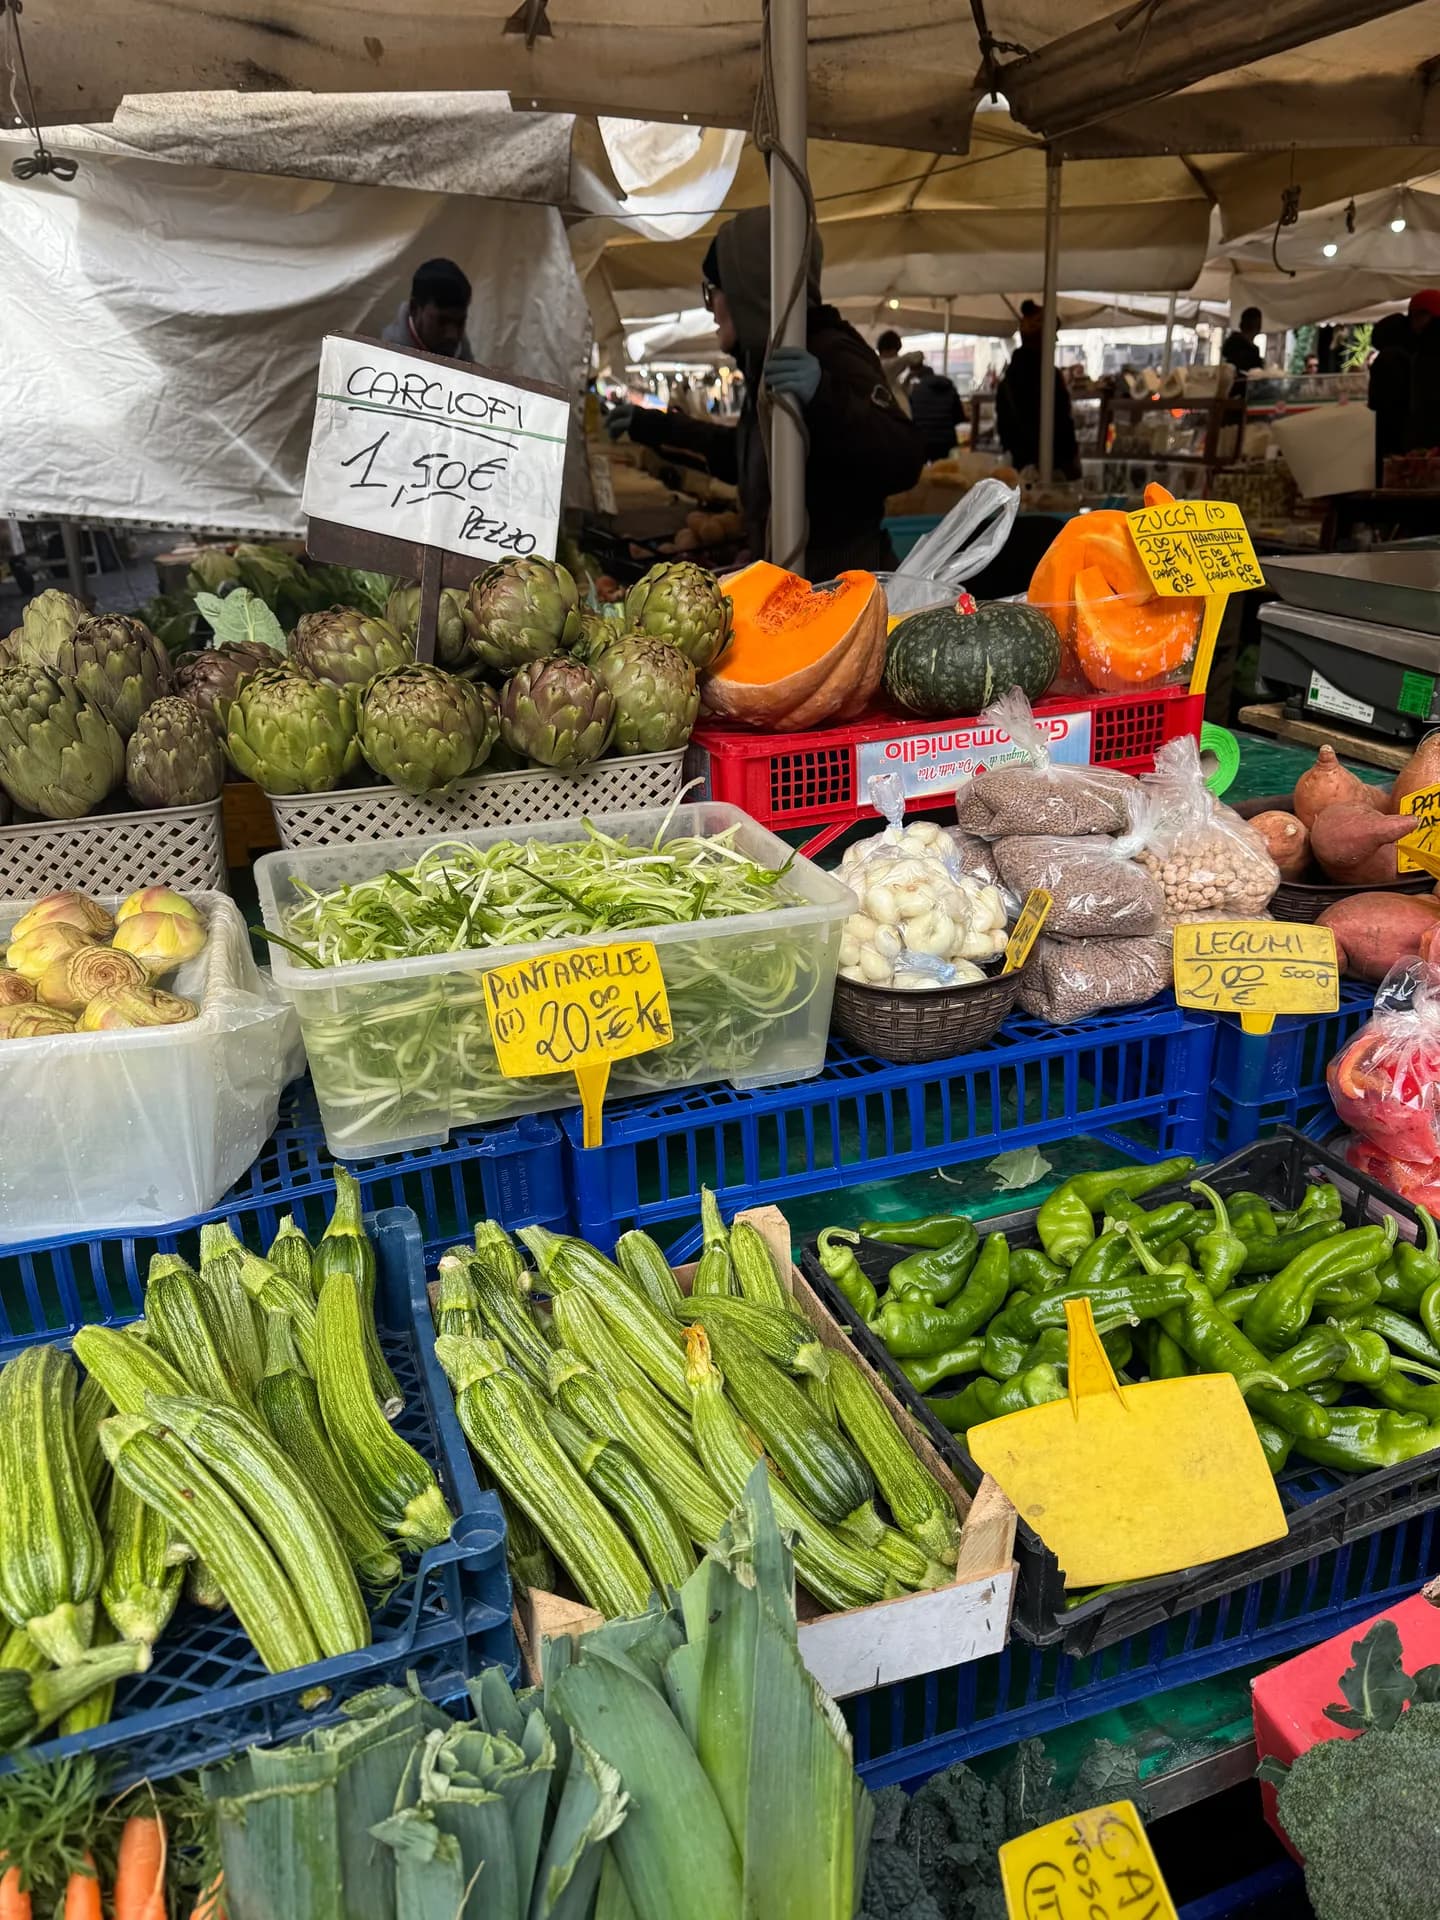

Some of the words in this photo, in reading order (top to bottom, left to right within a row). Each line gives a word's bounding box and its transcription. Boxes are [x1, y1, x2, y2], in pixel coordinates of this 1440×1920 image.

[347, 366, 523, 428] CARCIOFI
[458, 505, 537, 555] PEZZO
[1131, 505, 1198, 534] ZUCCA
[938, 761, 956, 776] tutti
[959, 758, 975, 774] Da
[1195, 930, 1304, 956] LEGUMI
[487, 947, 651, 1009] PUNTARELLE
[1279, 966, 1336, 988] 500g
[494, 1007, 526, 1044] (IT)
